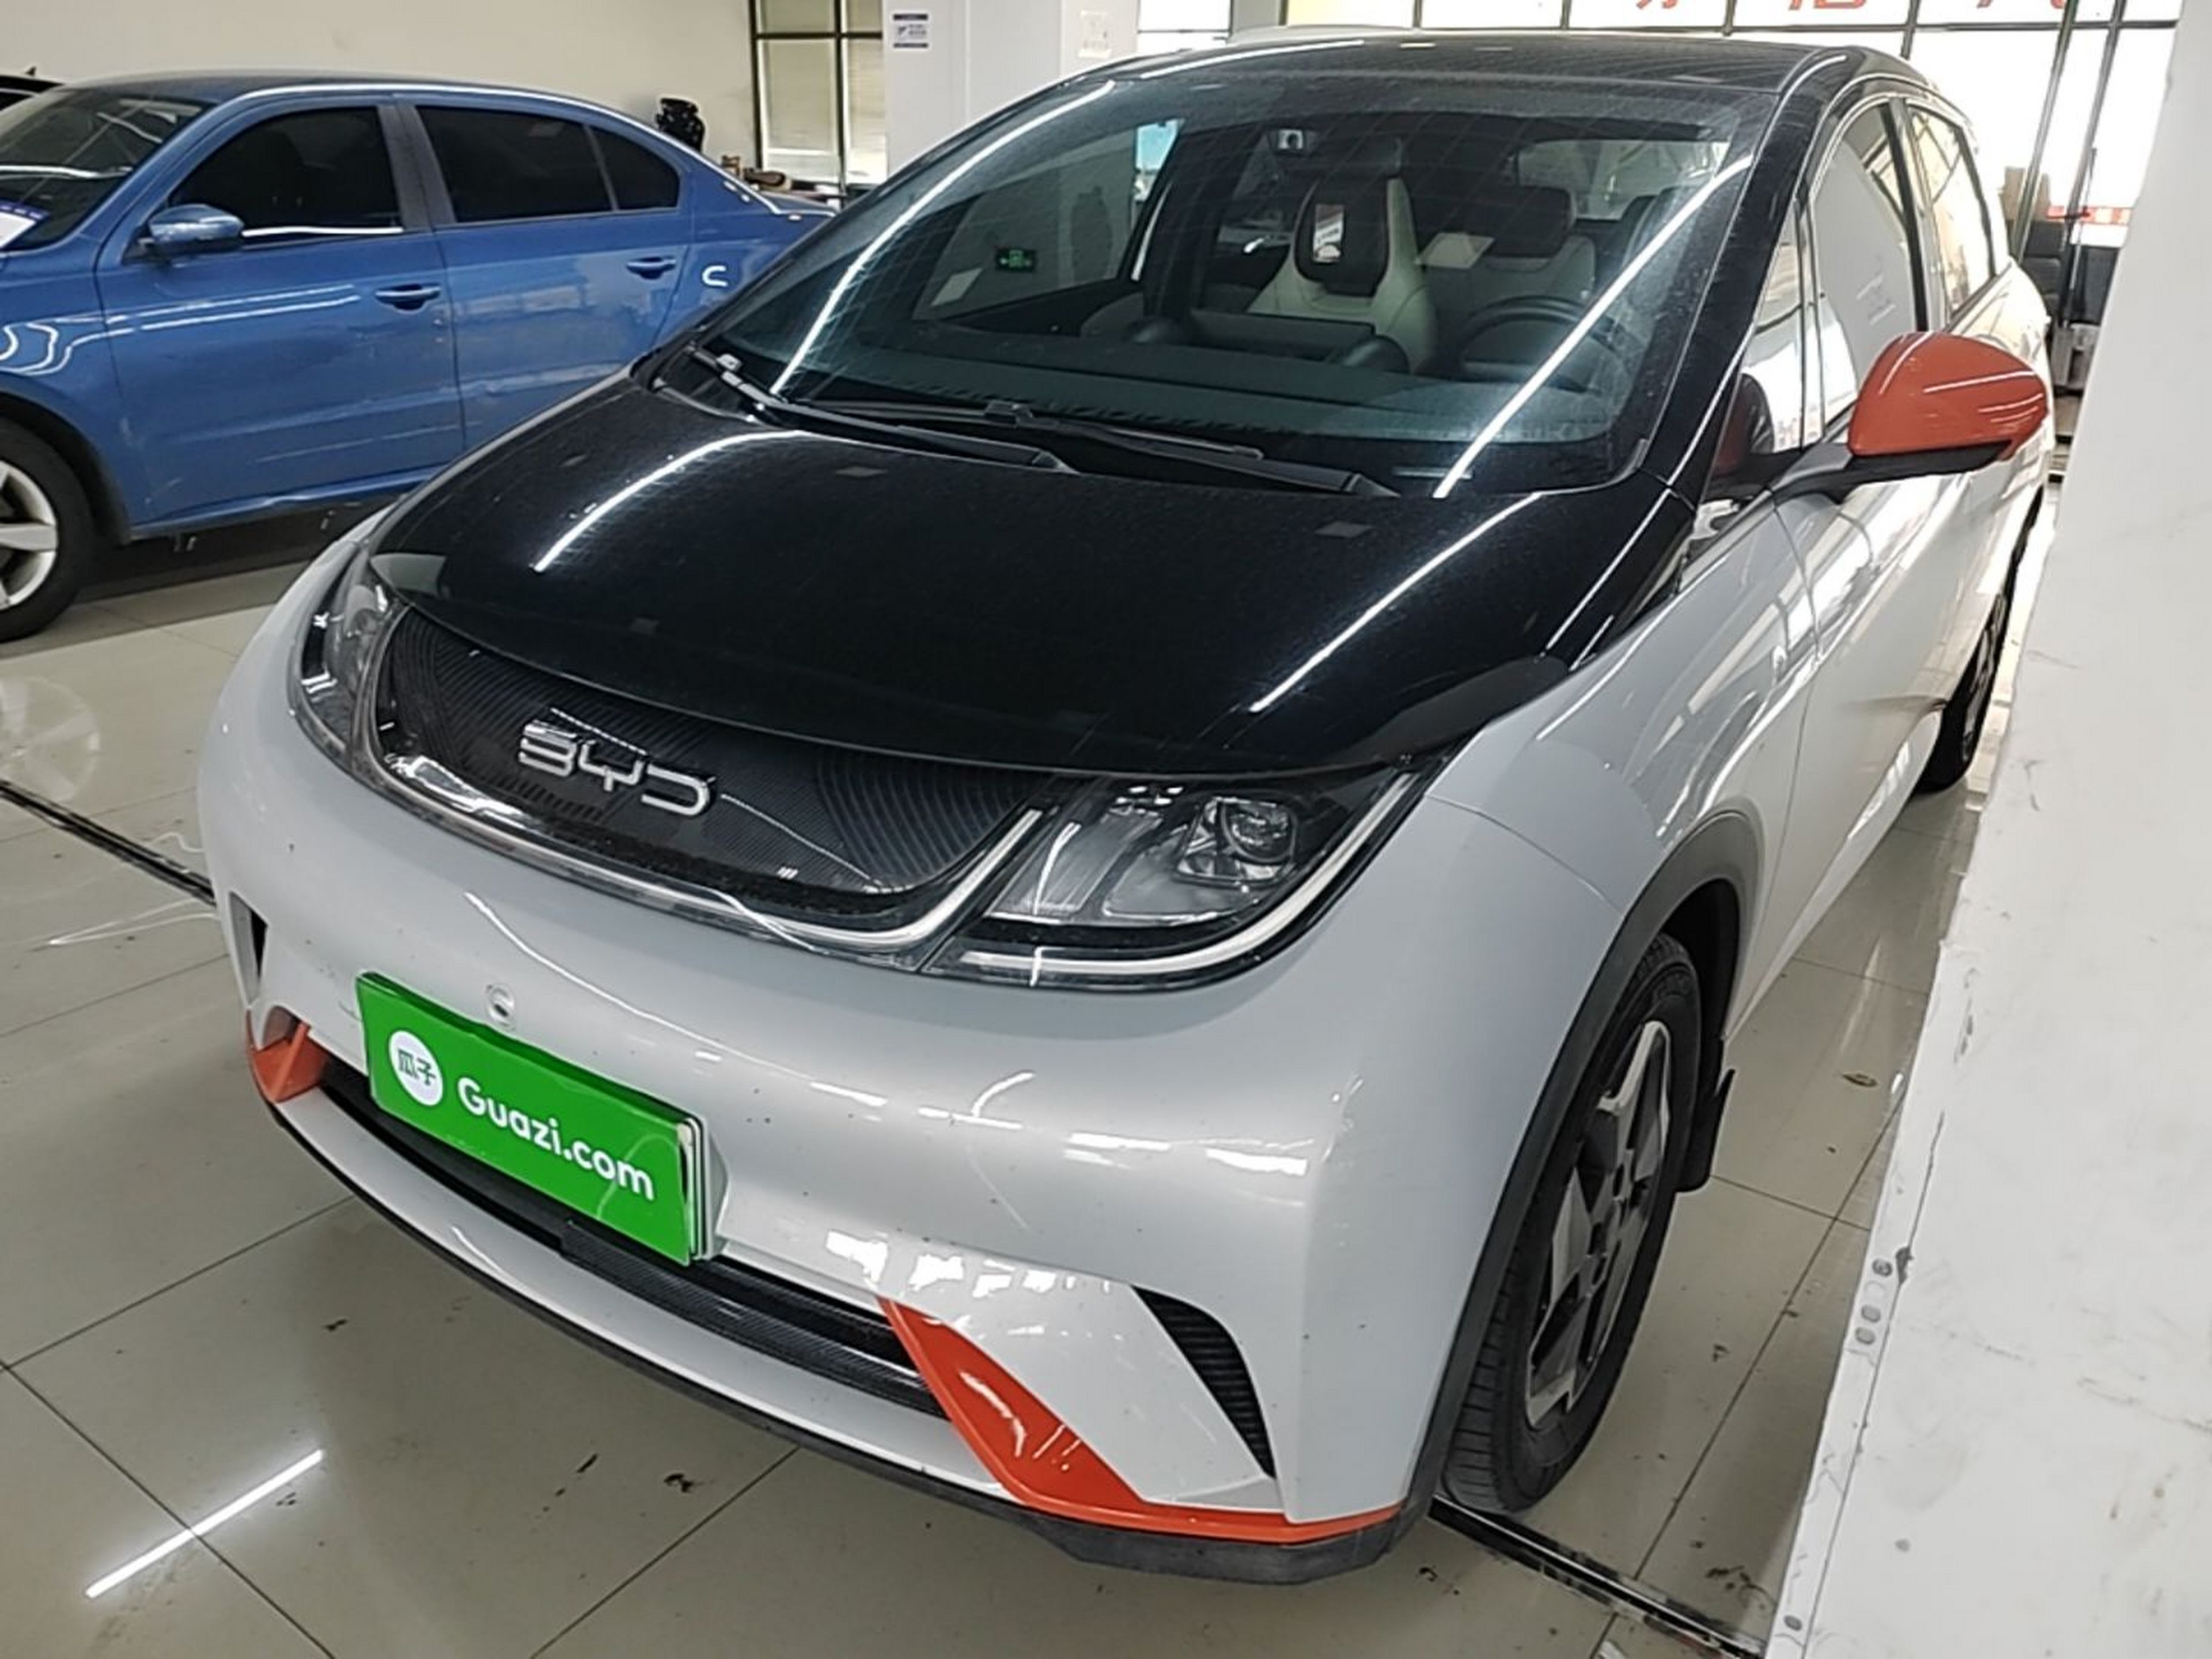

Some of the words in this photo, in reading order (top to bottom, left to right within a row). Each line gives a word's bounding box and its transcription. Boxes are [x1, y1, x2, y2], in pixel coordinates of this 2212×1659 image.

[519, 721, 710, 816] BYD
[397, 1048, 437, 1086] 瓜子
[457, 1077, 656, 1202] Guazi.com
